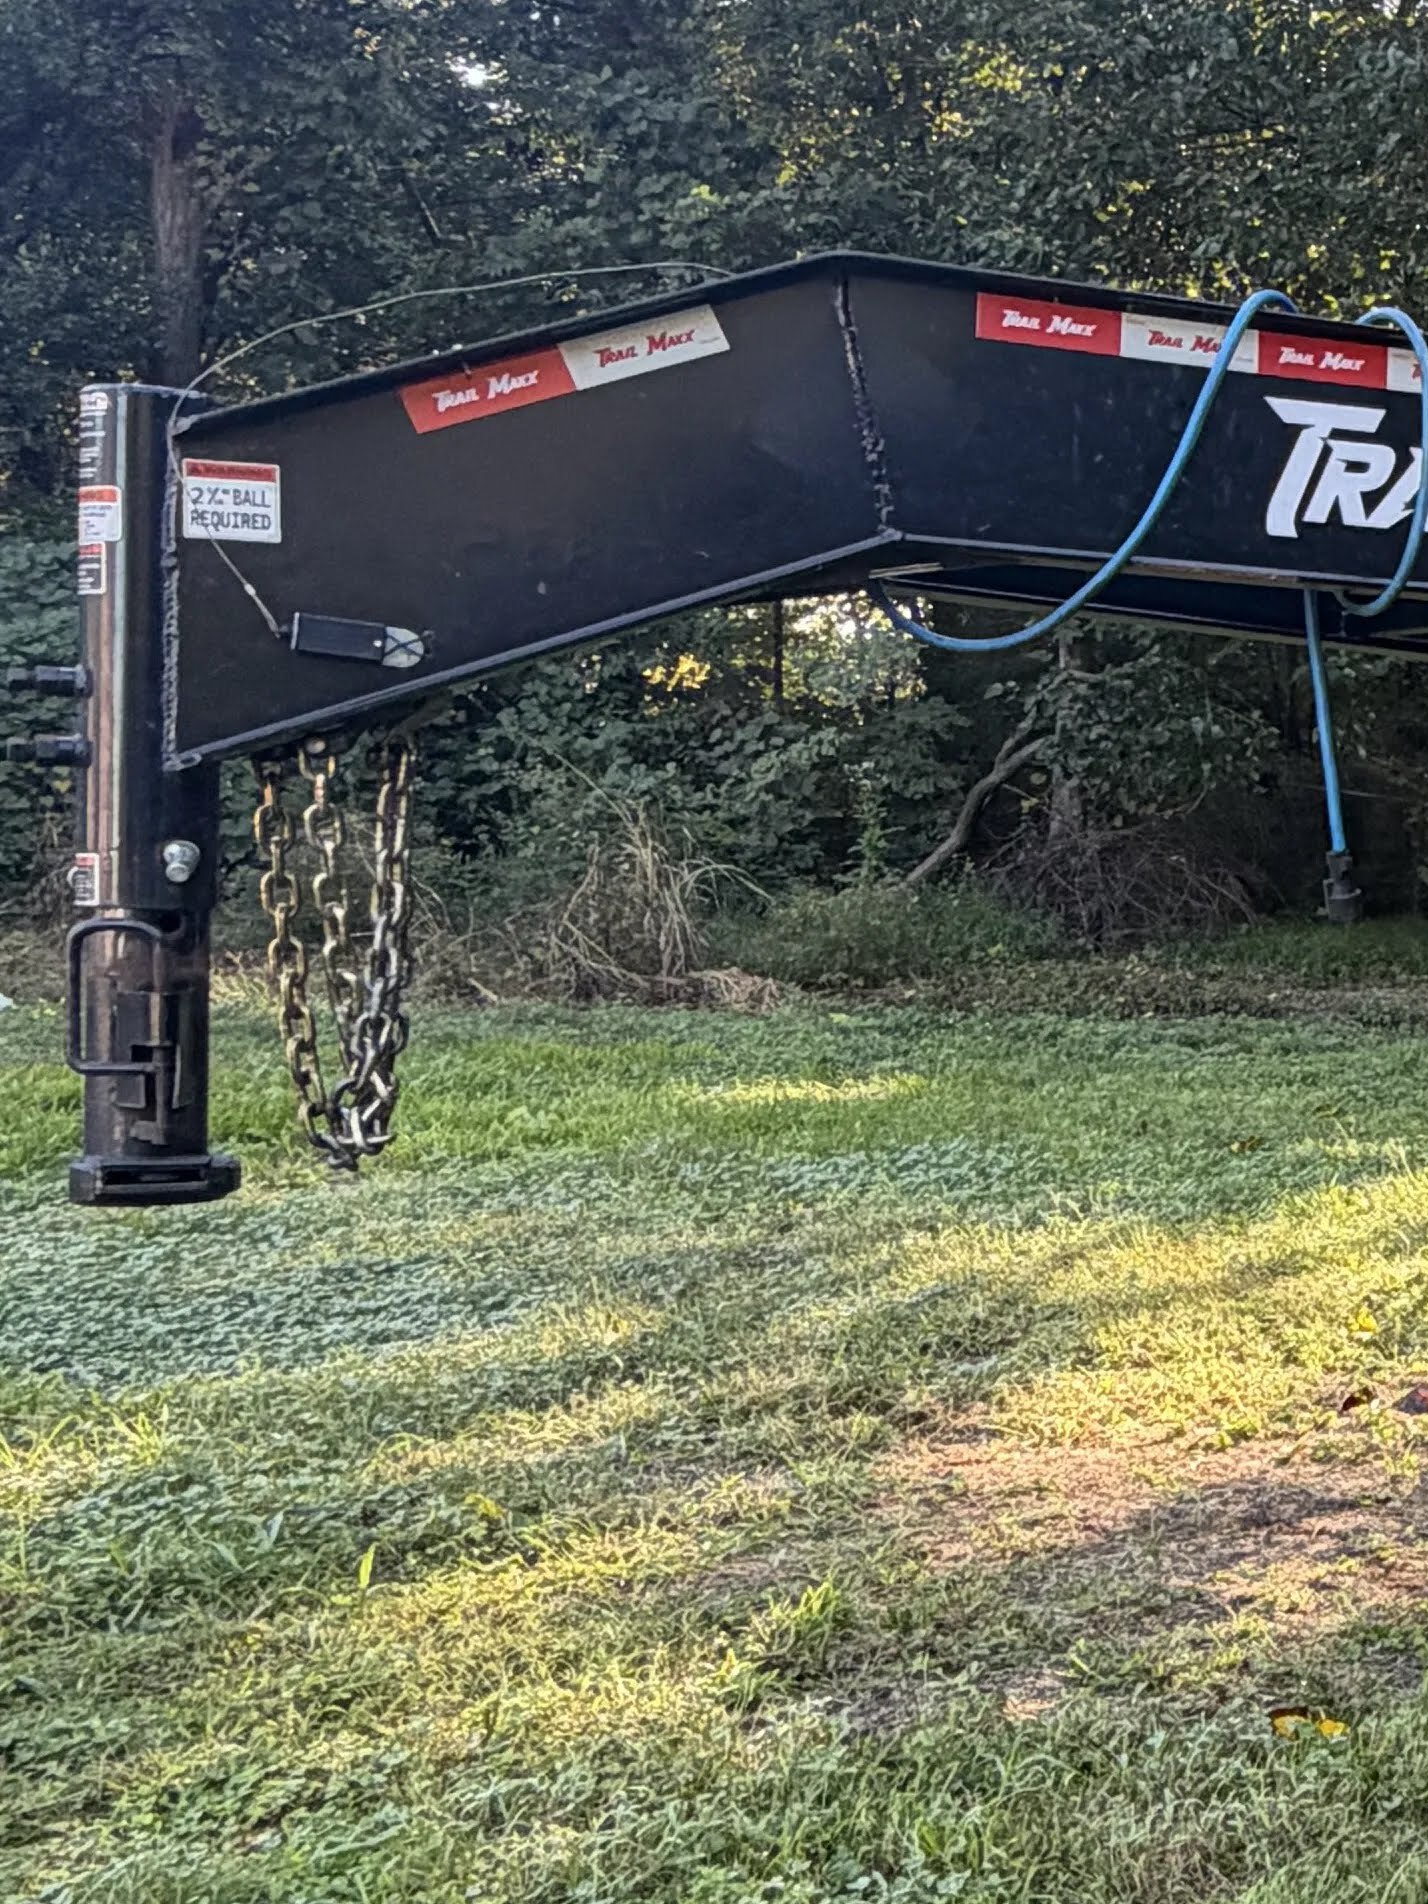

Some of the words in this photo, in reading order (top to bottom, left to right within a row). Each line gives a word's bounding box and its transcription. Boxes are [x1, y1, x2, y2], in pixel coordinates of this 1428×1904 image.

[1002, 309, 1041, 330] TRAIL
[1046, 314, 1098, 337] MAXX
[593, 345, 639, 368] TRAIL
[645, 329, 696, 356] MAXX
[1148, 329, 1184, 348] TRAIL
[1278, 346, 1315, 366] TRAIL
[1318, 351, 1366, 372] MAXX
[432, 387, 480, 413] TRAIL
[487, 370, 541, 400] MAXX
[231, 488, 271, 509] BALL
[190, 508, 272, 532] REQUIRED
